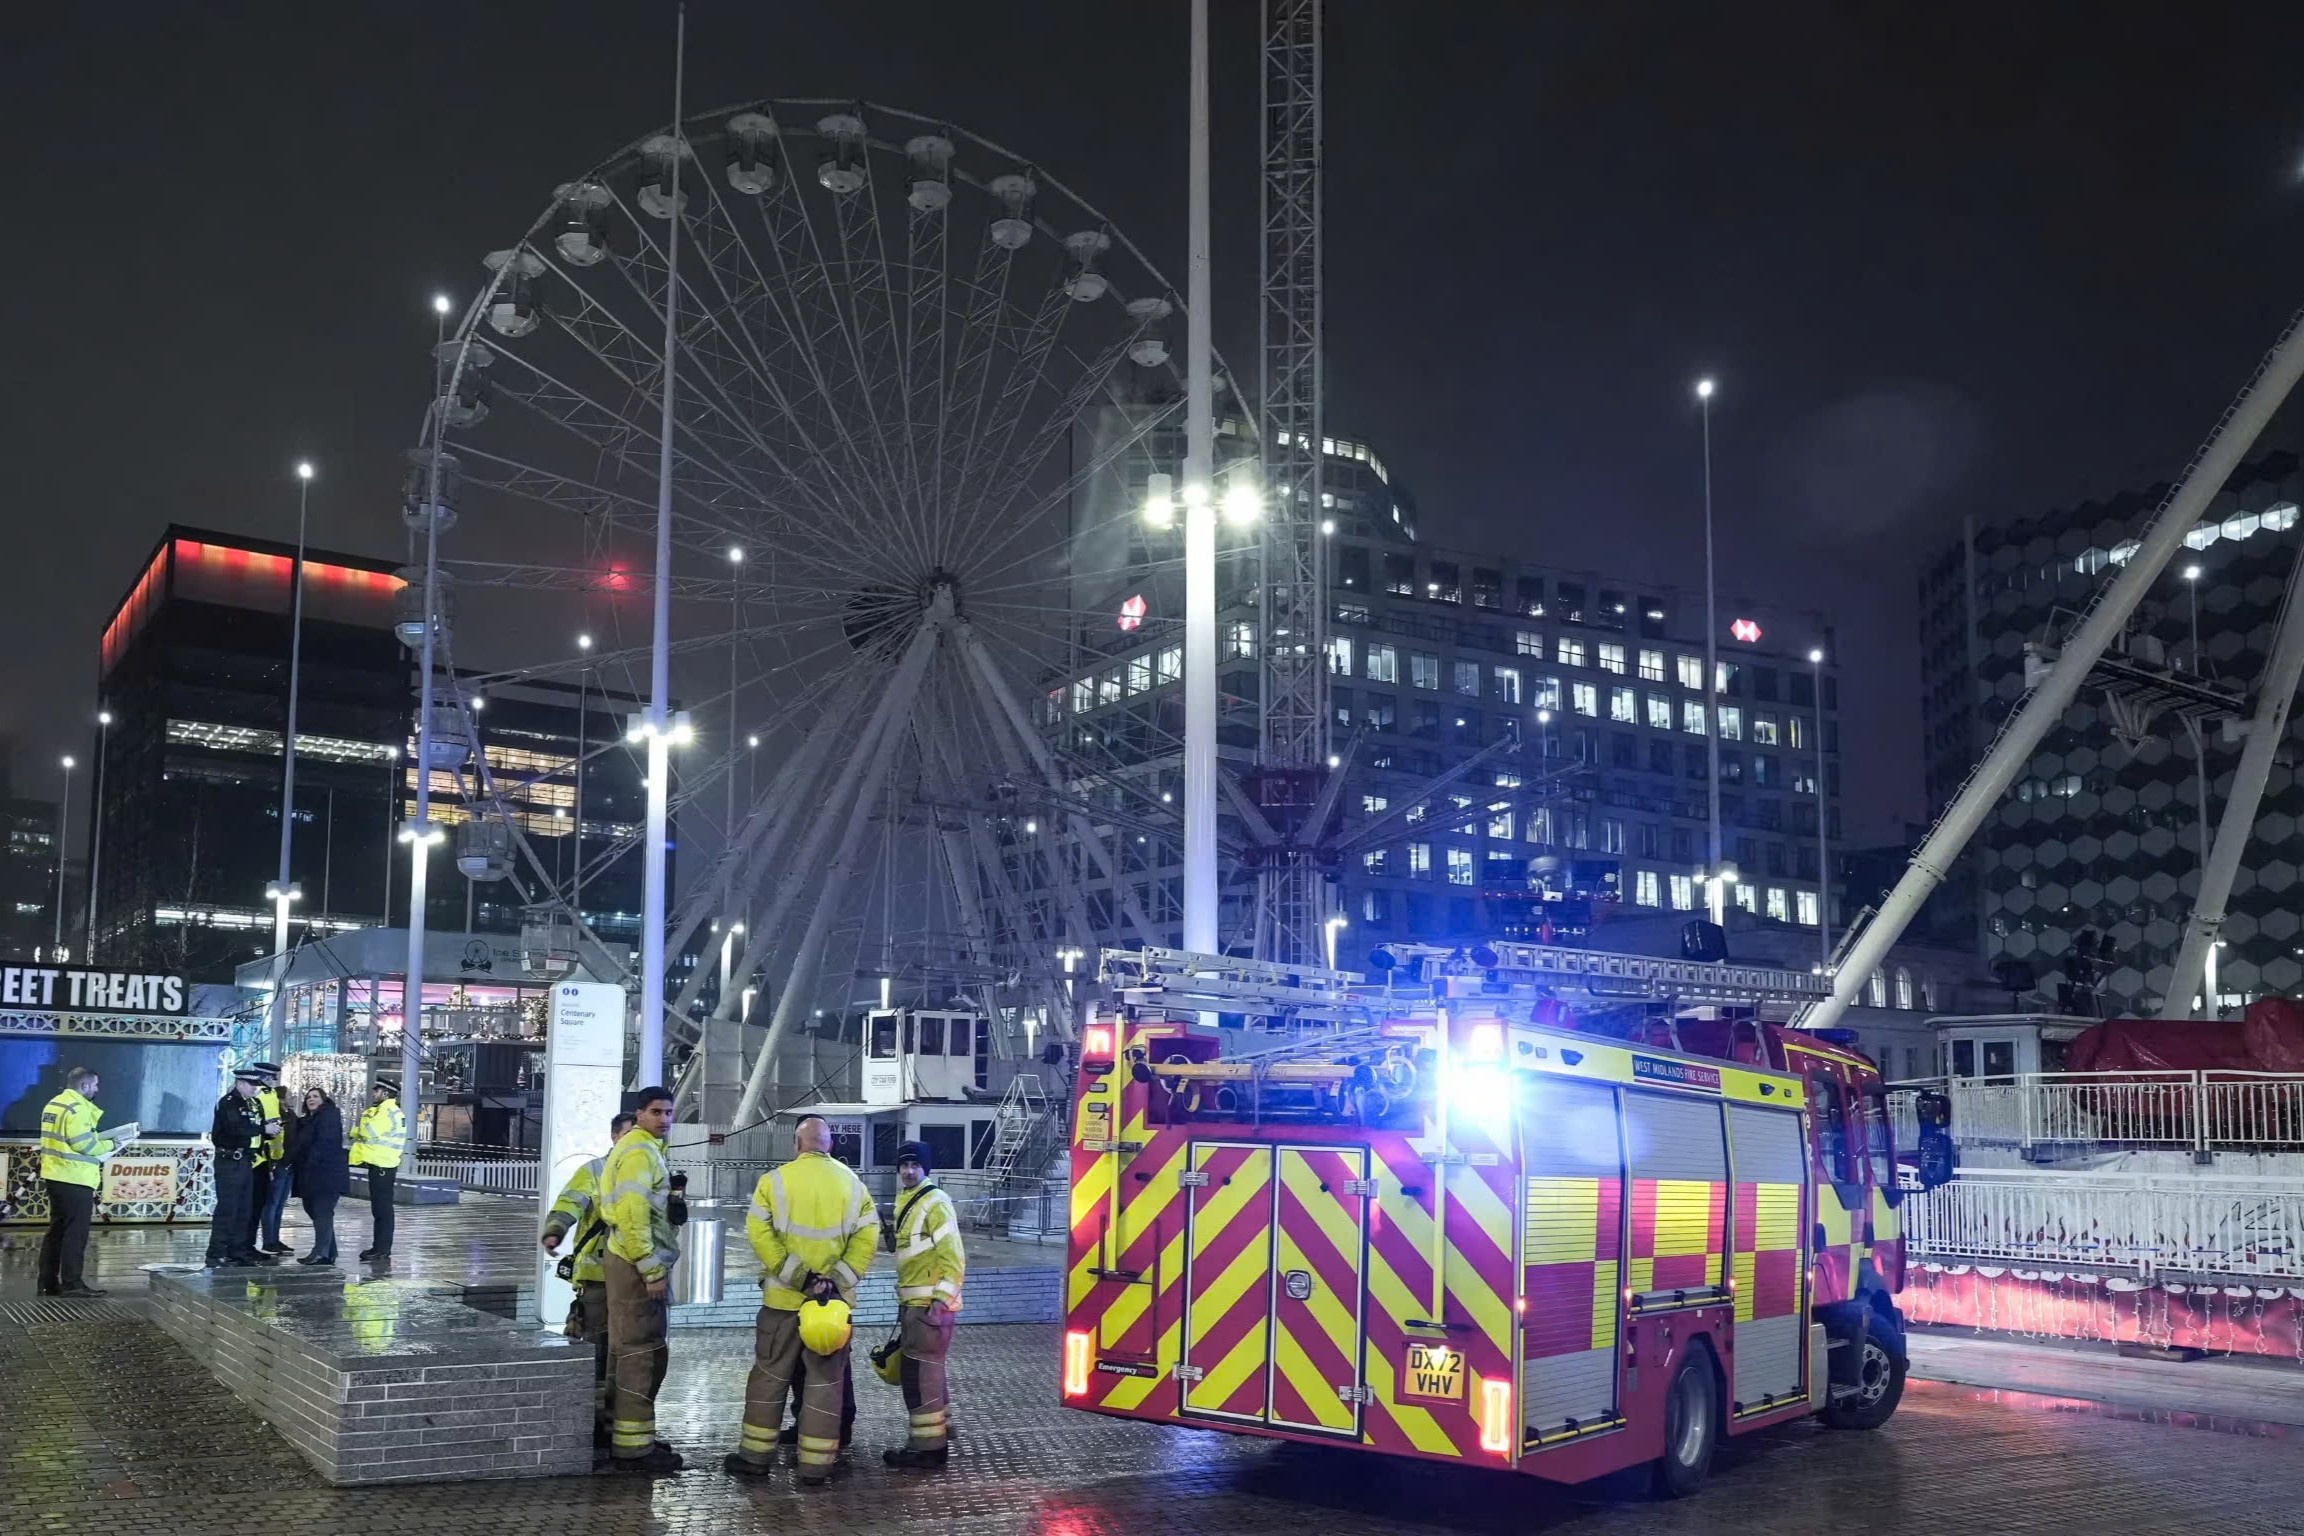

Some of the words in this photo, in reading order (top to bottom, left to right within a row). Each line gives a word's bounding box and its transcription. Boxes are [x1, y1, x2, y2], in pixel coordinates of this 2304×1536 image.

[0, 967, 59, 1004] EET
[66, 971, 183, 1011] TREATS
[560, 1008, 596, 1018] Centenary
[560, 1018, 585, 1026] Square
[1634, 1060, 1651, 1073] WEST
[1652, 1063, 1684, 1079] MIDLANDS
[1684, 1069, 1697, 1081] FIRE
[1697, 1071, 1719, 1084] SERVICE
[842, 1124, 862, 1133] HERE
[110, 1164, 170, 1177] Donuts
[1098, 1362, 1138, 1375] Emergency
[1417, 1373, 1453, 1394] VHV
